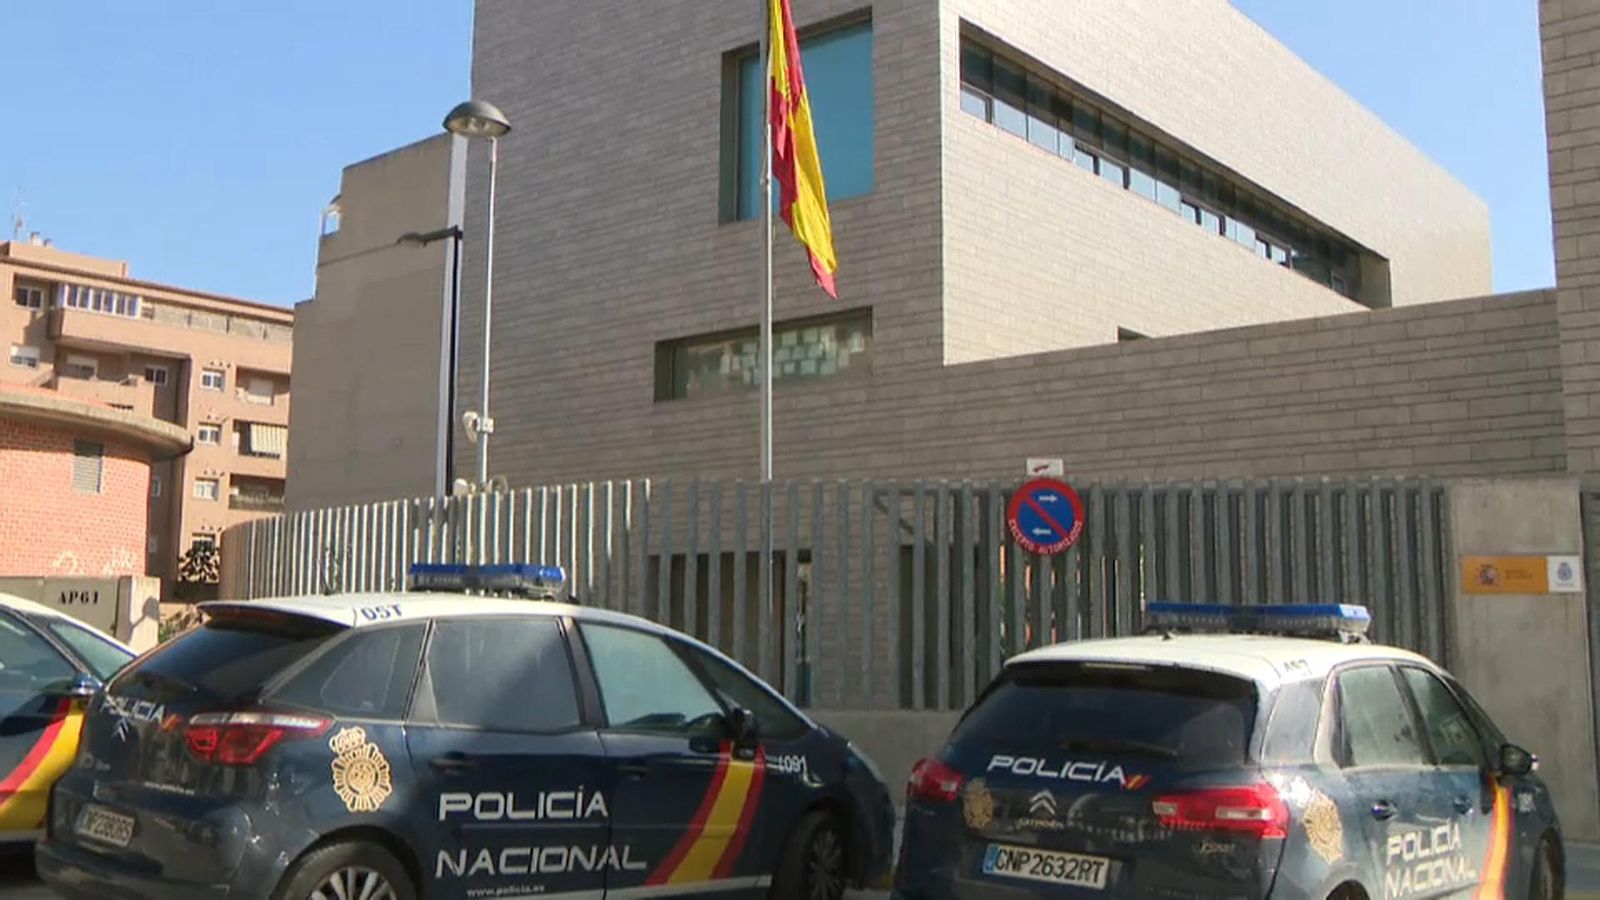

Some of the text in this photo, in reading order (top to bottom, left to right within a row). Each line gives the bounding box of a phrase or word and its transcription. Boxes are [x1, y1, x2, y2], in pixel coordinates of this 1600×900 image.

[986, 751, 1126, 785] POLICÍA
[438, 785, 608, 821] POLICÍA
[434, 845, 648, 879] NACIONAL
[994, 849, 1105, 884] CNP2632RT
